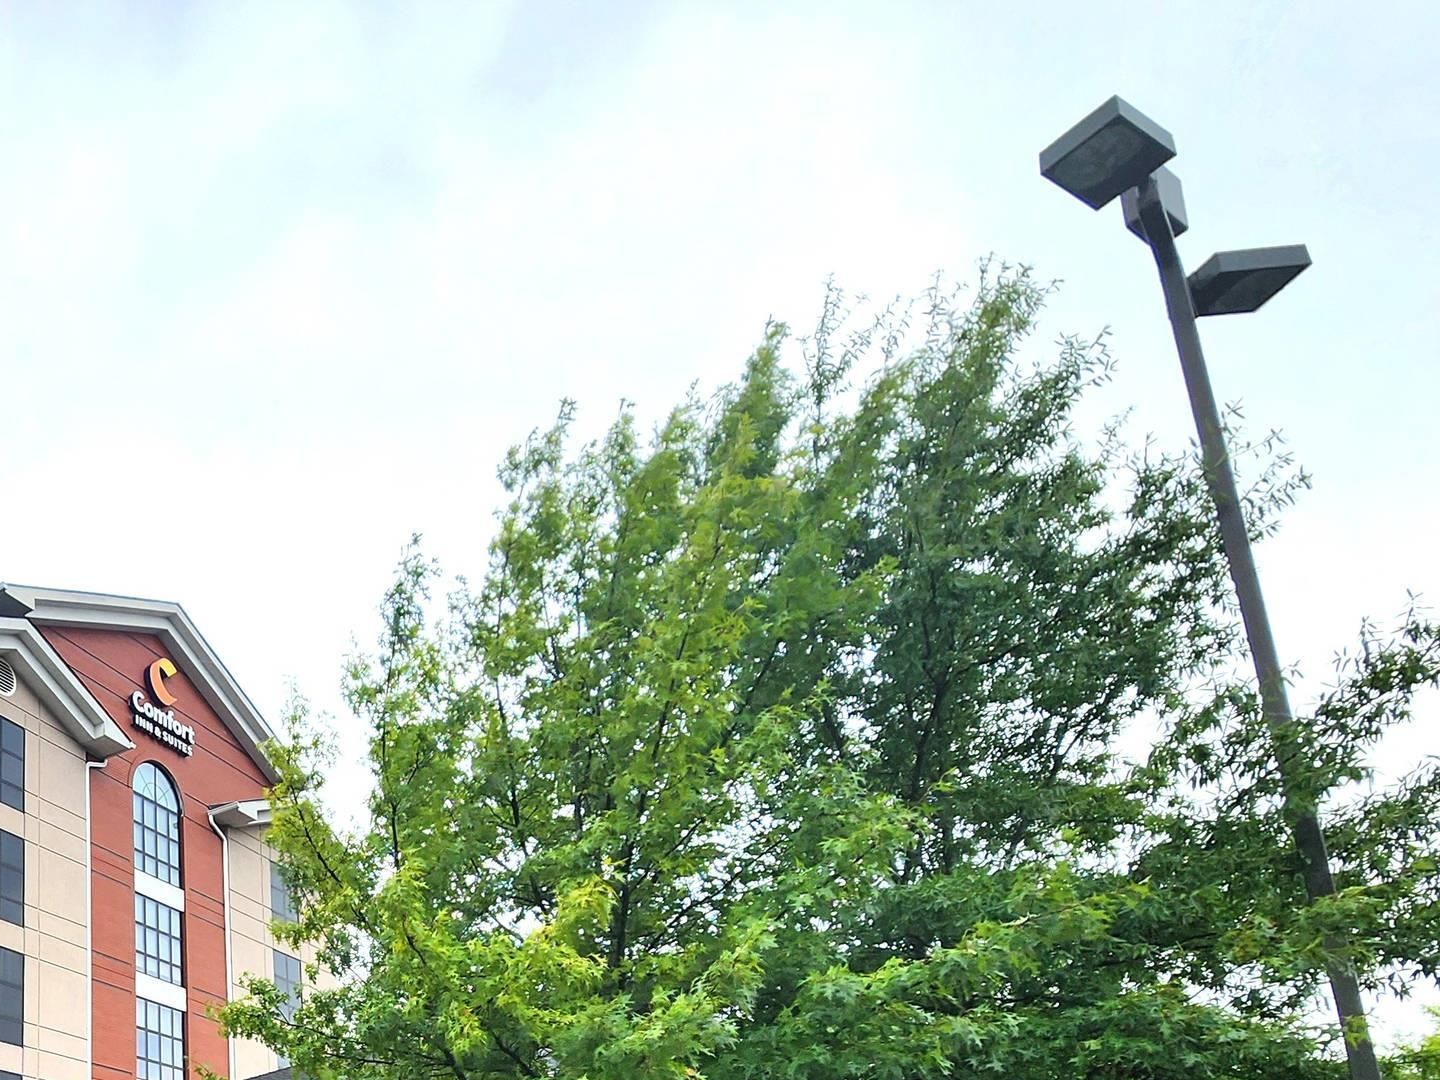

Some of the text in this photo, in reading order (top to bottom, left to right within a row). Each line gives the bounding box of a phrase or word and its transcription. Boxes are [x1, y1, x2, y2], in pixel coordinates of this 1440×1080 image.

[132, 690, 195, 745] Comfort
[135, 714, 193, 756] INN & SUITES
